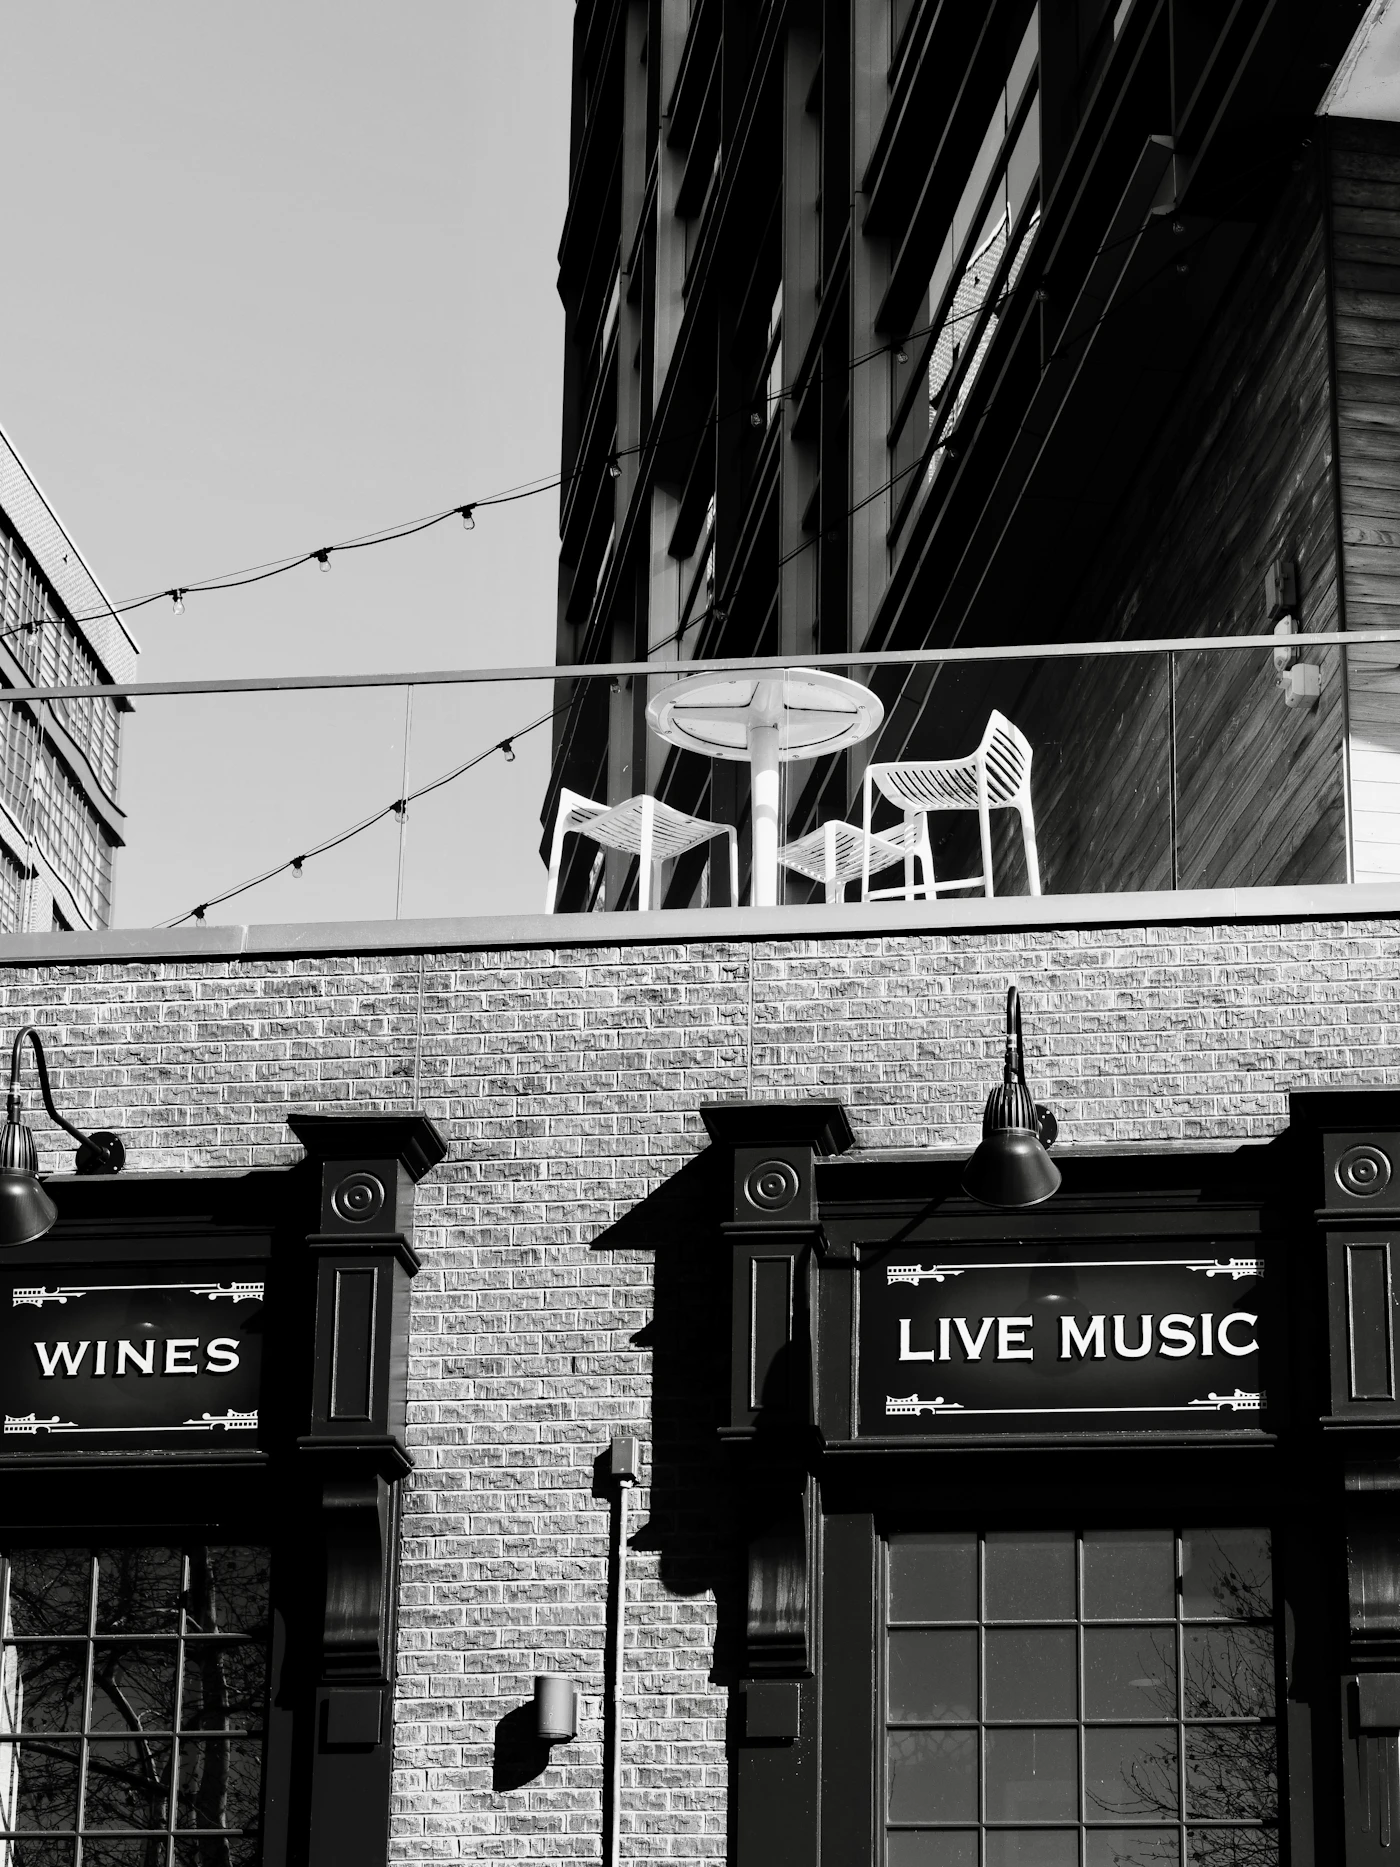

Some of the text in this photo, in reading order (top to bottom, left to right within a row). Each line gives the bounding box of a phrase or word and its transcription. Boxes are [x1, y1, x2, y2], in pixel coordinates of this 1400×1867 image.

[33, 1337, 240, 1377] WINES
[898, 1312, 1260, 1363] LIVE MUSIC
